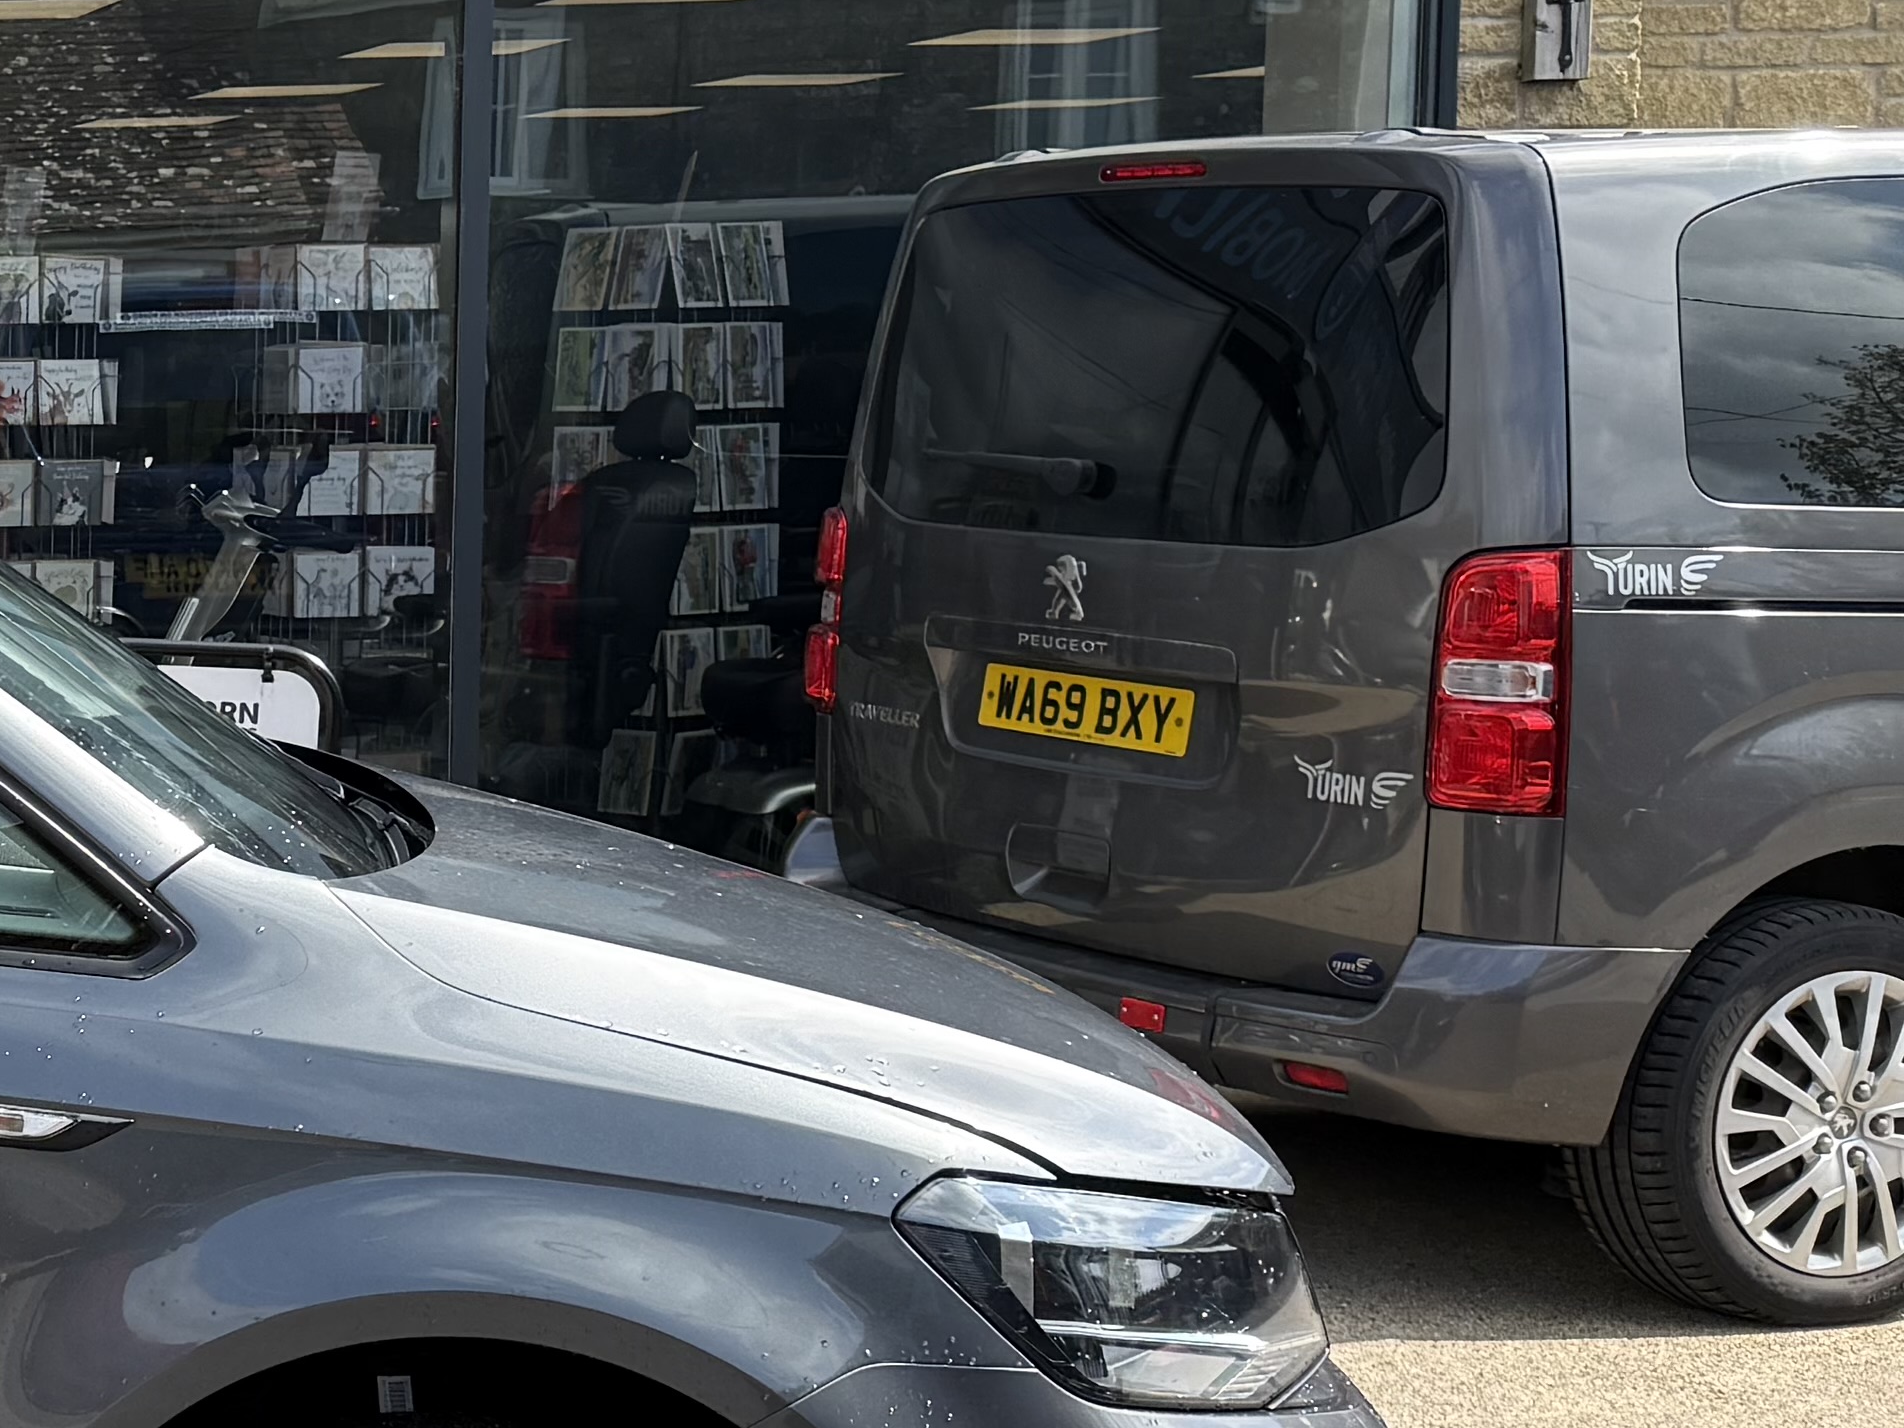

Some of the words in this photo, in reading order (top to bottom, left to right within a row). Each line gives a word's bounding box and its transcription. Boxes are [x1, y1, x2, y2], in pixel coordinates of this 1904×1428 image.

[1587, 550, 1674, 596] TURIN
[1017, 632, 1109, 655] PEUGEOT
[848, 700, 921, 728] TRAVELLER
[995, 672, 1088, 730] WA69
[1094, 687, 1177, 744] BXY
[1294, 754, 1365, 807] TURIN
